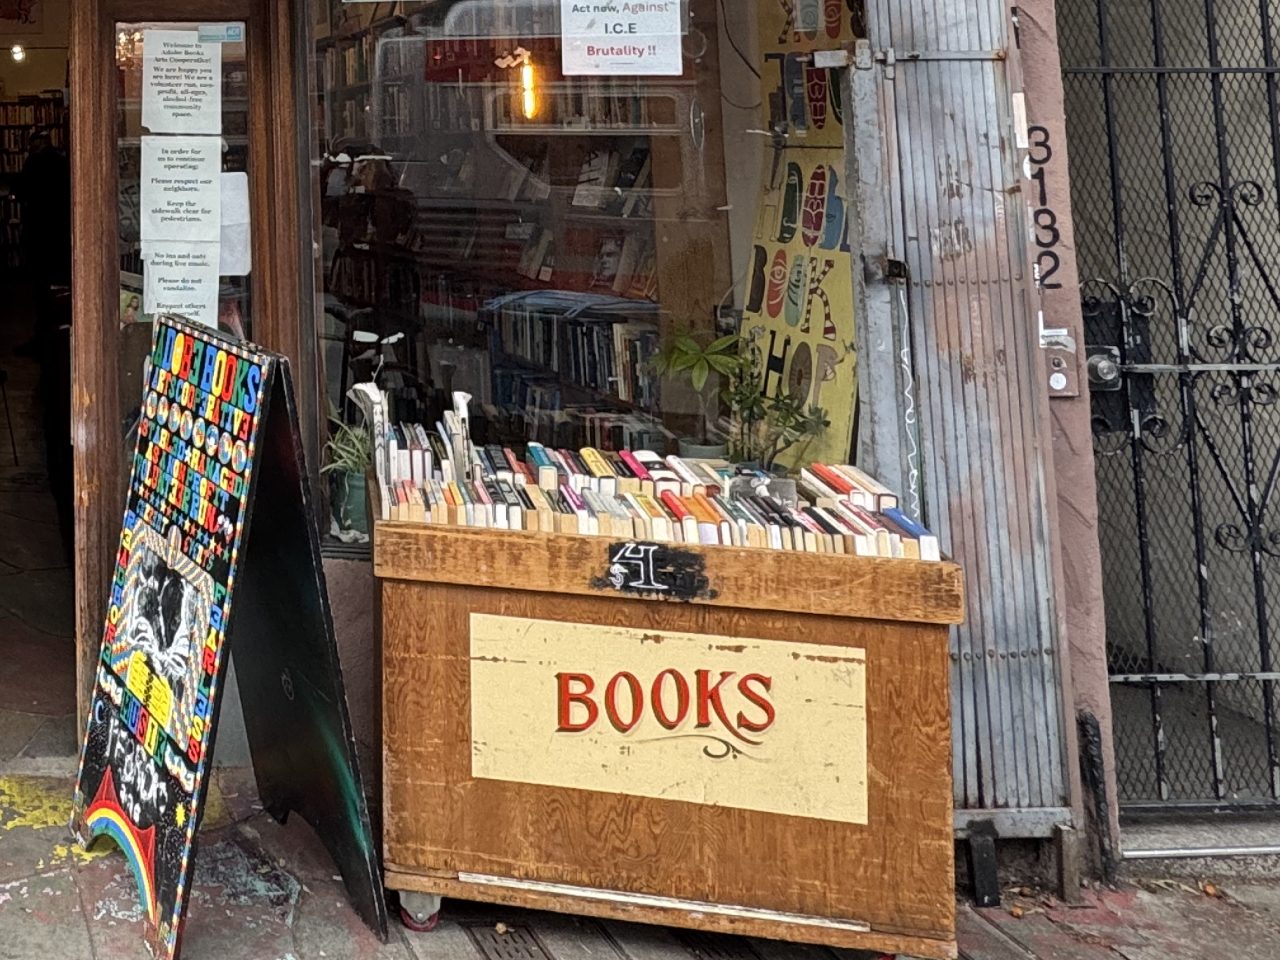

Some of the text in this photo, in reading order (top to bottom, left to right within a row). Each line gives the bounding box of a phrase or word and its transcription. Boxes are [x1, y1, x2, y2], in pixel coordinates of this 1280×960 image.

[572, 2, 669, 14] Act now, Against
[604, 22, 638, 34] I.C.E
[587, 45, 657, 58] Brutality !!
[151, 367, 176, 399] ARTS
[200, 344, 260, 413] BOOKS
[555, 667, 776, 745] BOOKS
